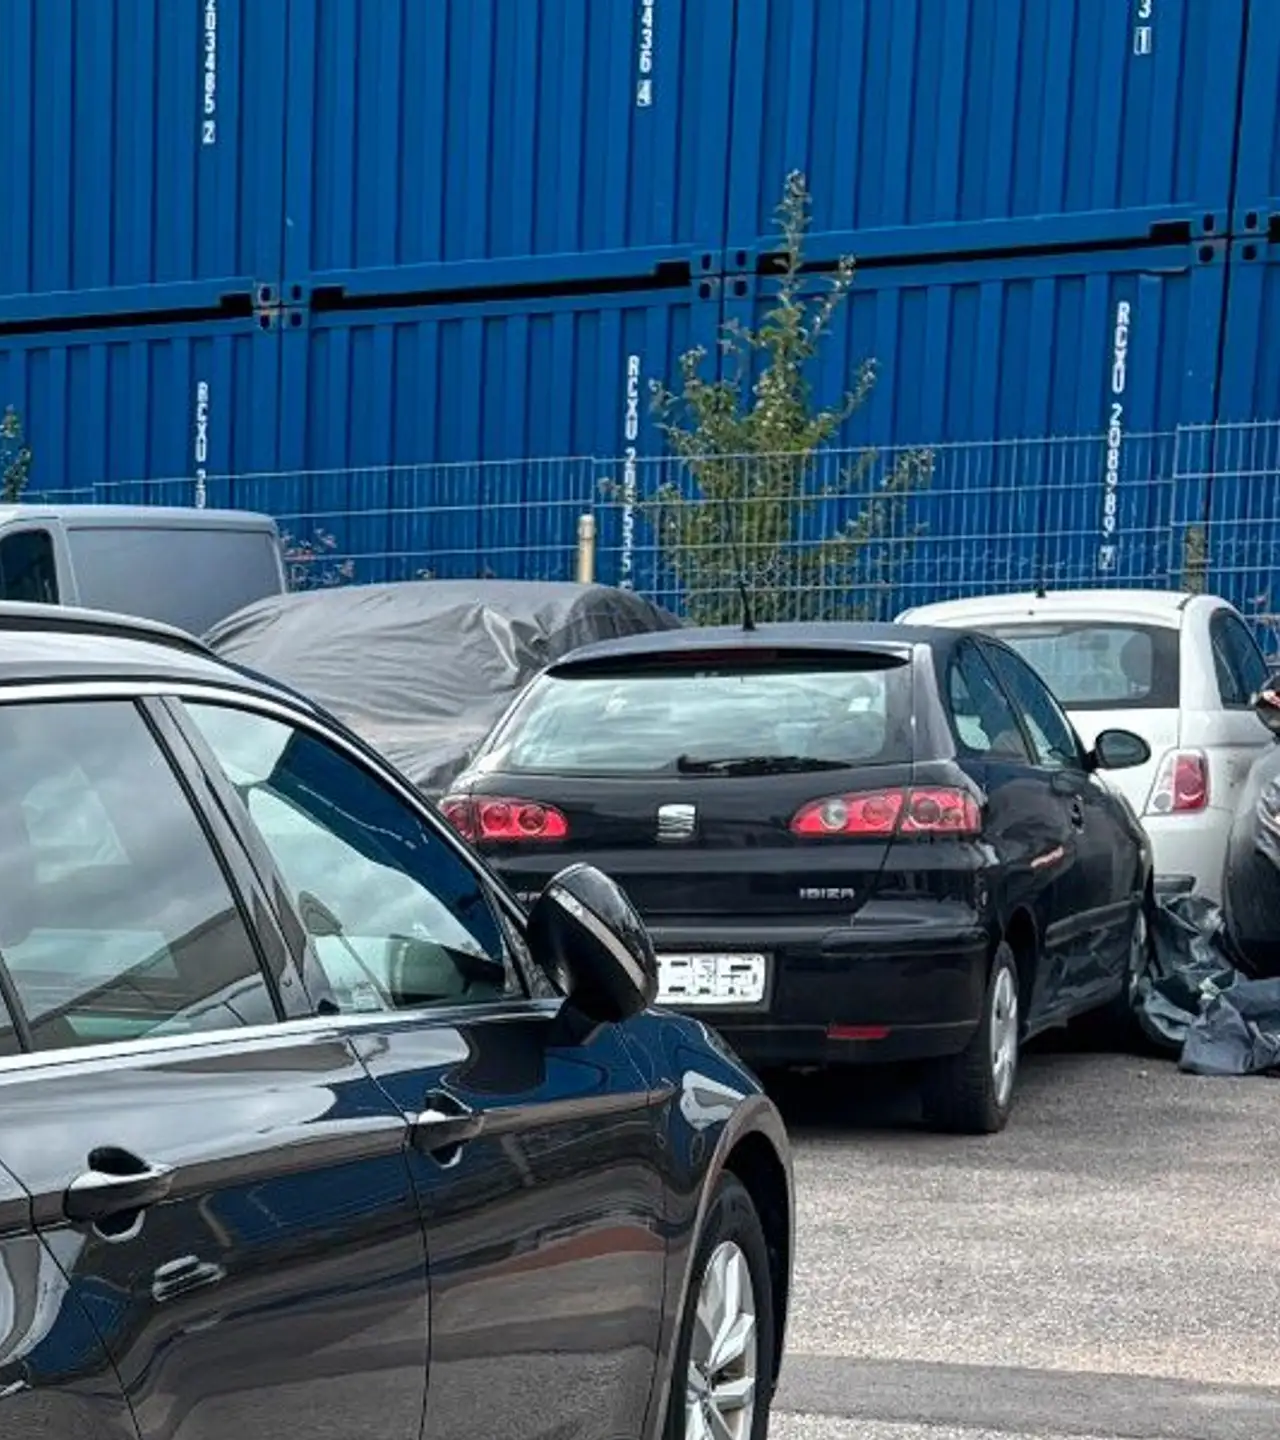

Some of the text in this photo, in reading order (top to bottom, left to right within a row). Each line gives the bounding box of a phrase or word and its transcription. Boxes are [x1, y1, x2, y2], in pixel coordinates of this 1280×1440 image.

[1111, 301, 1130, 394] RCXU
[194, 381, 208, 463] RCXU
[624, 355, 640, 440] RCXU
[1103, 403, 1124, 540] 208989
[799, 887, 856, 899] IBIZA
